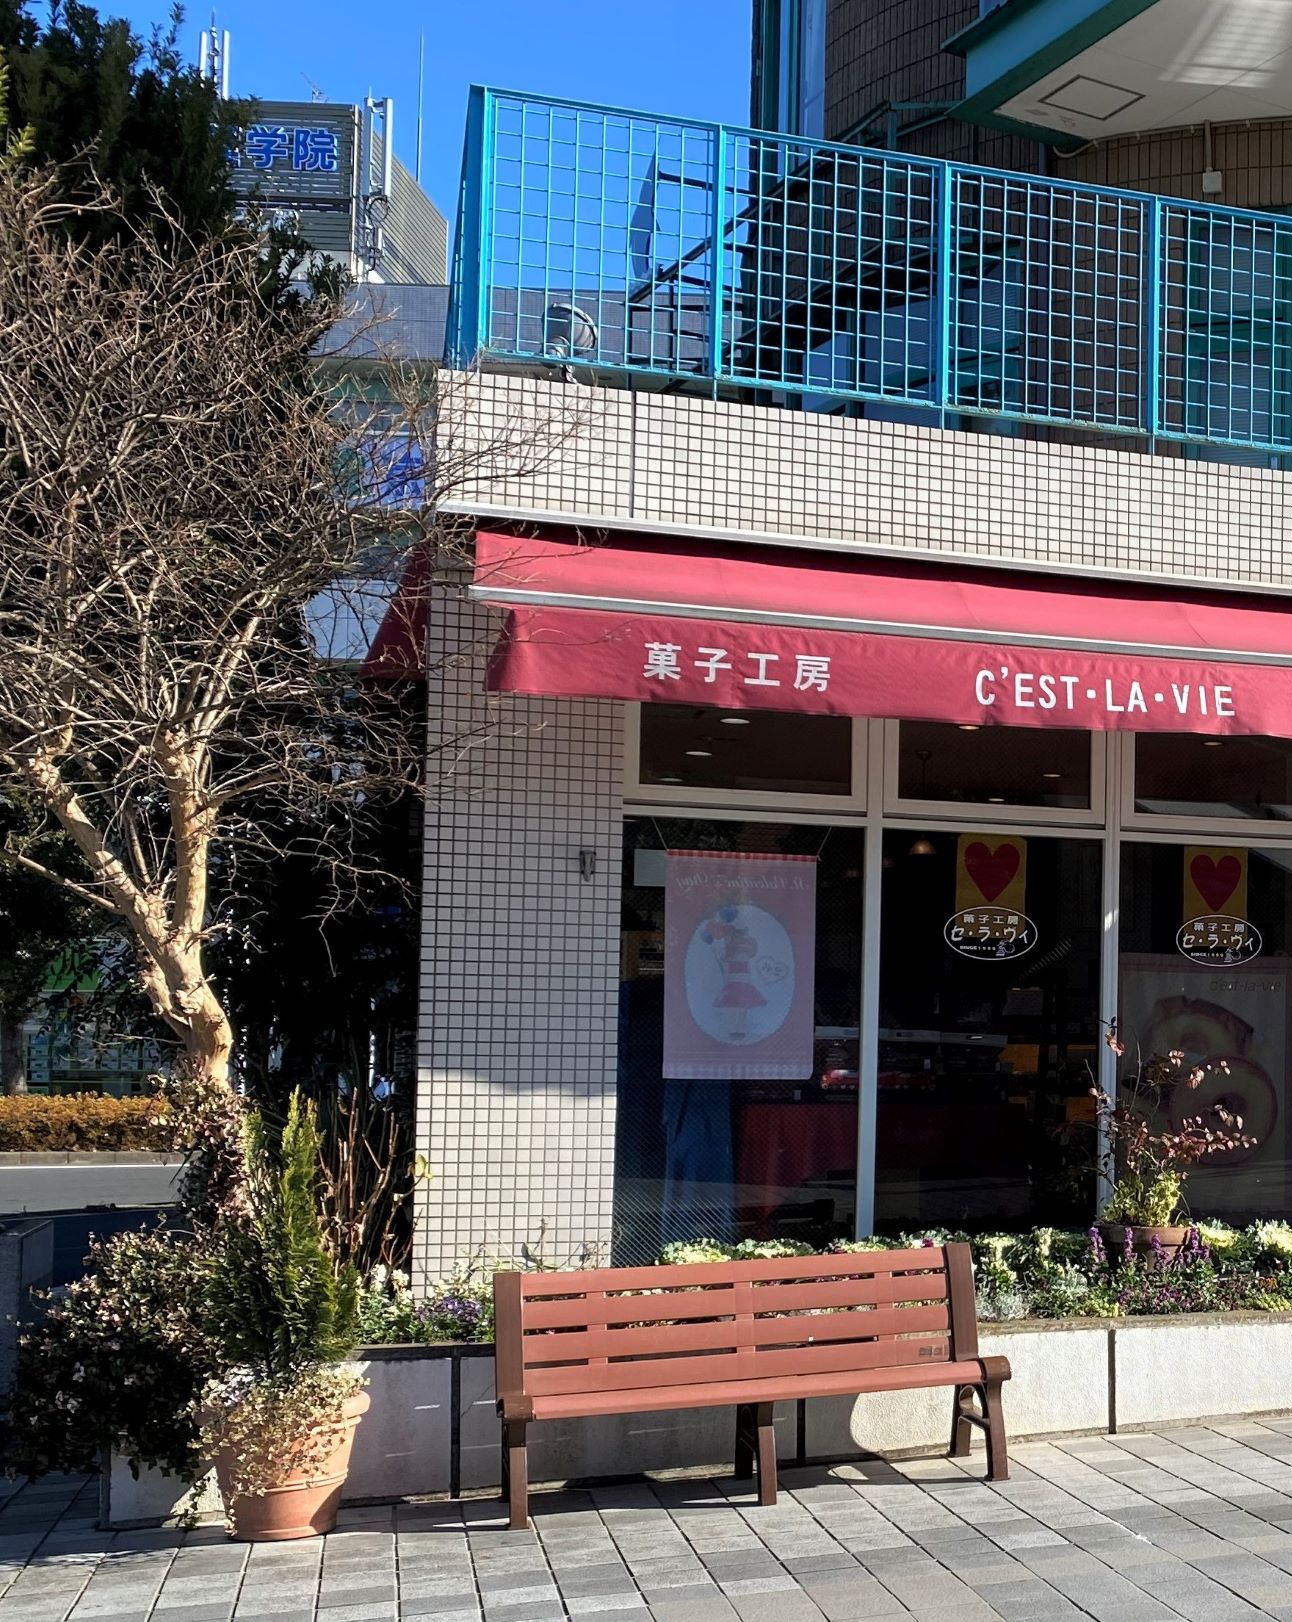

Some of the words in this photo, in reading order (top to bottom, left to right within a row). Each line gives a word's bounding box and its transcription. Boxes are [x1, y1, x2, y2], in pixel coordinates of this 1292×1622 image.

[642, 641, 832, 693] 菓子工房
[963, 913, 1019, 925] 菓子工房
[1193, 922, 1245, 933] 菓子工房
